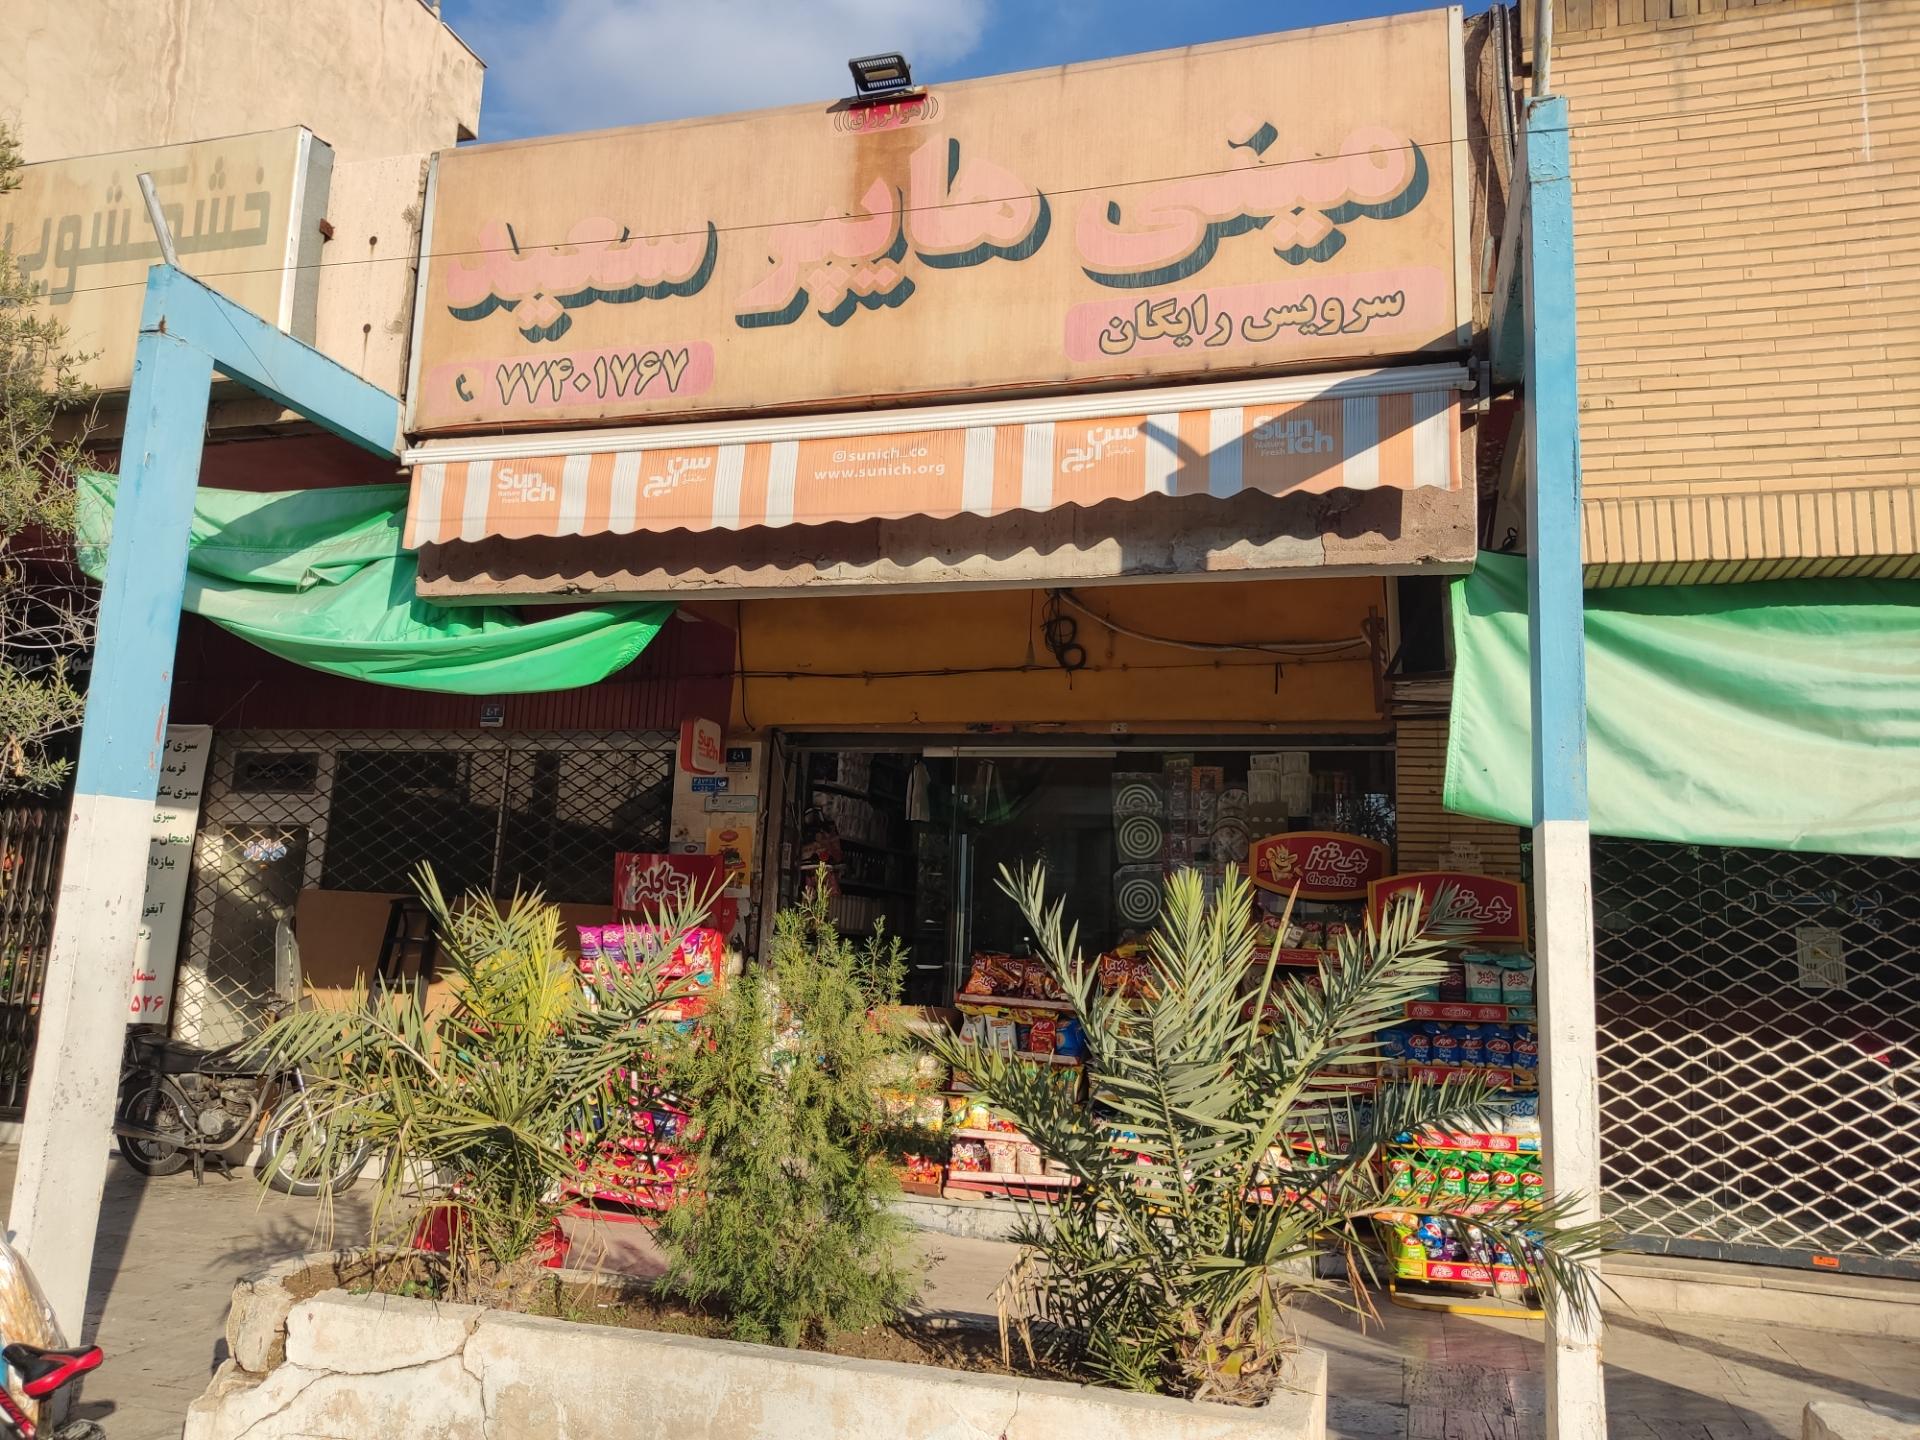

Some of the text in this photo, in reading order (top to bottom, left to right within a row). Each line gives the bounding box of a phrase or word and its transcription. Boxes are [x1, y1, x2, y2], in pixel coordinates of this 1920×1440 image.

[446, 117, 1430, 343] مینی هایپر سعید
[1098, 289, 1406, 355] سرویس رایگان
[495, 347, 689, 406] ۷۷۴۰۱۷۶۷
[814, 463, 945, 480] www.sunich.org
[173, 741, 199, 752] سبزی
[173, 788, 199, 799] سبزی
[152, 811, 177, 823] سبزی
[149, 856, 175, 870] پیازدا
[143, 901, 165, 917] آبغو
[132, 967, 157, 984] شمار
